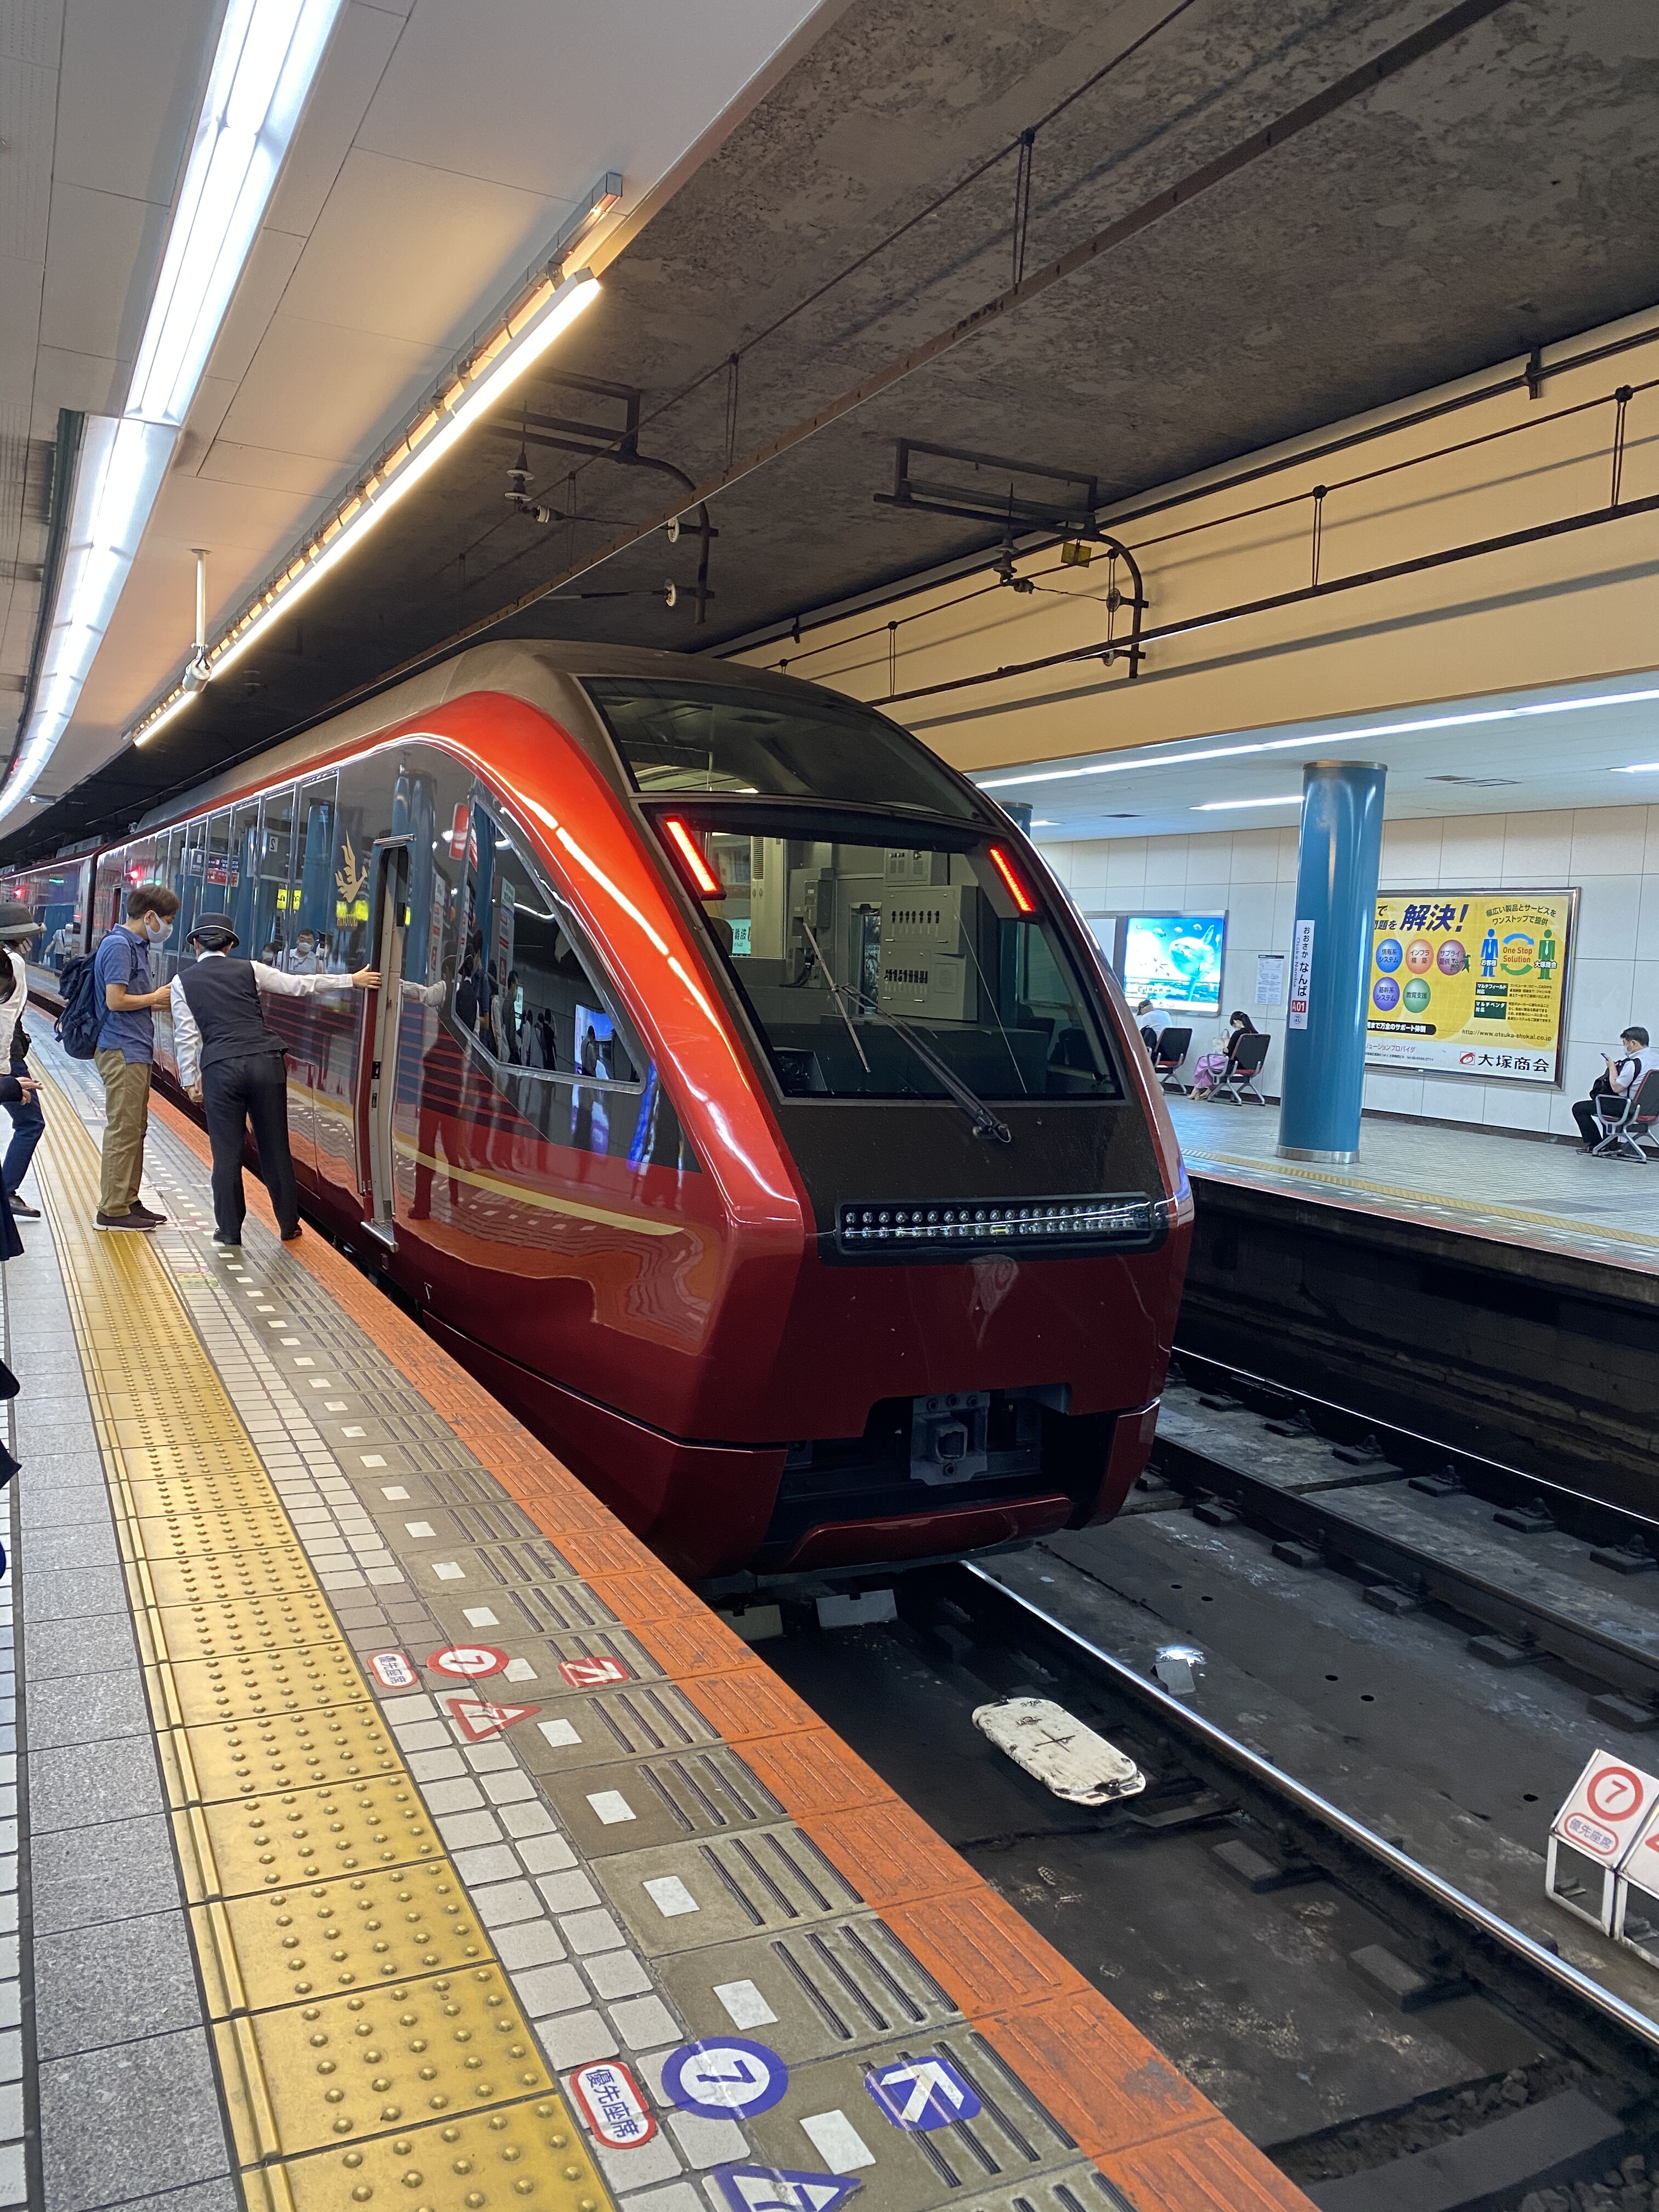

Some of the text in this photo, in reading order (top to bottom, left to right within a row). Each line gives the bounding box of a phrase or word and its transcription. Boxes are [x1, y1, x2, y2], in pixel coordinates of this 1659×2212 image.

[1378, 906, 1388, 916] で
[1493, 915, 1548, 926] ワンストップで提供
[1292, 1001, 1305, 1012] A01
[1478, 1054, 1549, 1073] 大塚商会
[379, 1656, 406, 1684] 優先座席
[449, 1656, 484, 1664] 7
[1605, 1780, 1628, 1803] 7
[1569, 1819, 1613, 1849] 優先座席
[696, 2060, 756, 2083] 7
[585, 2069, 639, 2138] 優先座席
